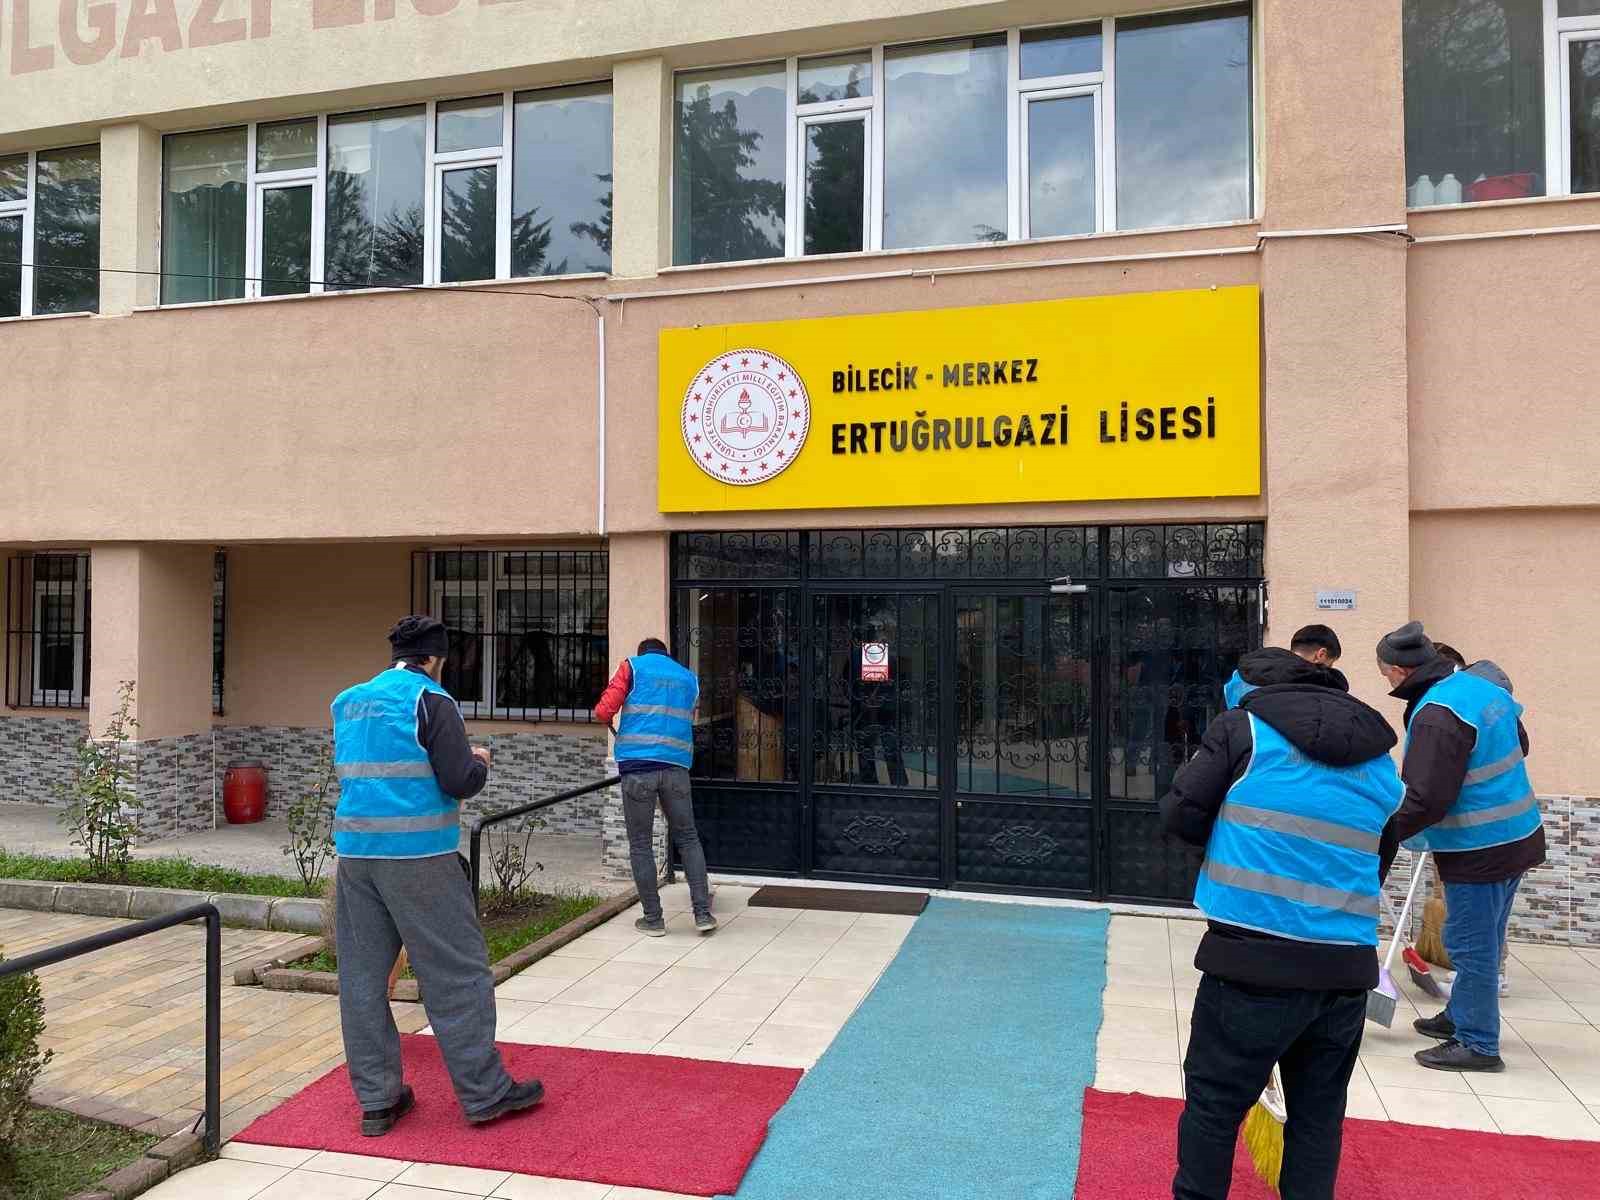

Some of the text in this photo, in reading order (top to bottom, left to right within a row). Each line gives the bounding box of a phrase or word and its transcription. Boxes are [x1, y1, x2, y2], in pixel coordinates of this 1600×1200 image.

[832, 361, 918, 393] BİLECİK
[943, 358, 1038, 388] MERKEZ
[832, 397, 1216, 455] ERTUĞRULGAZİ LİSESİ
